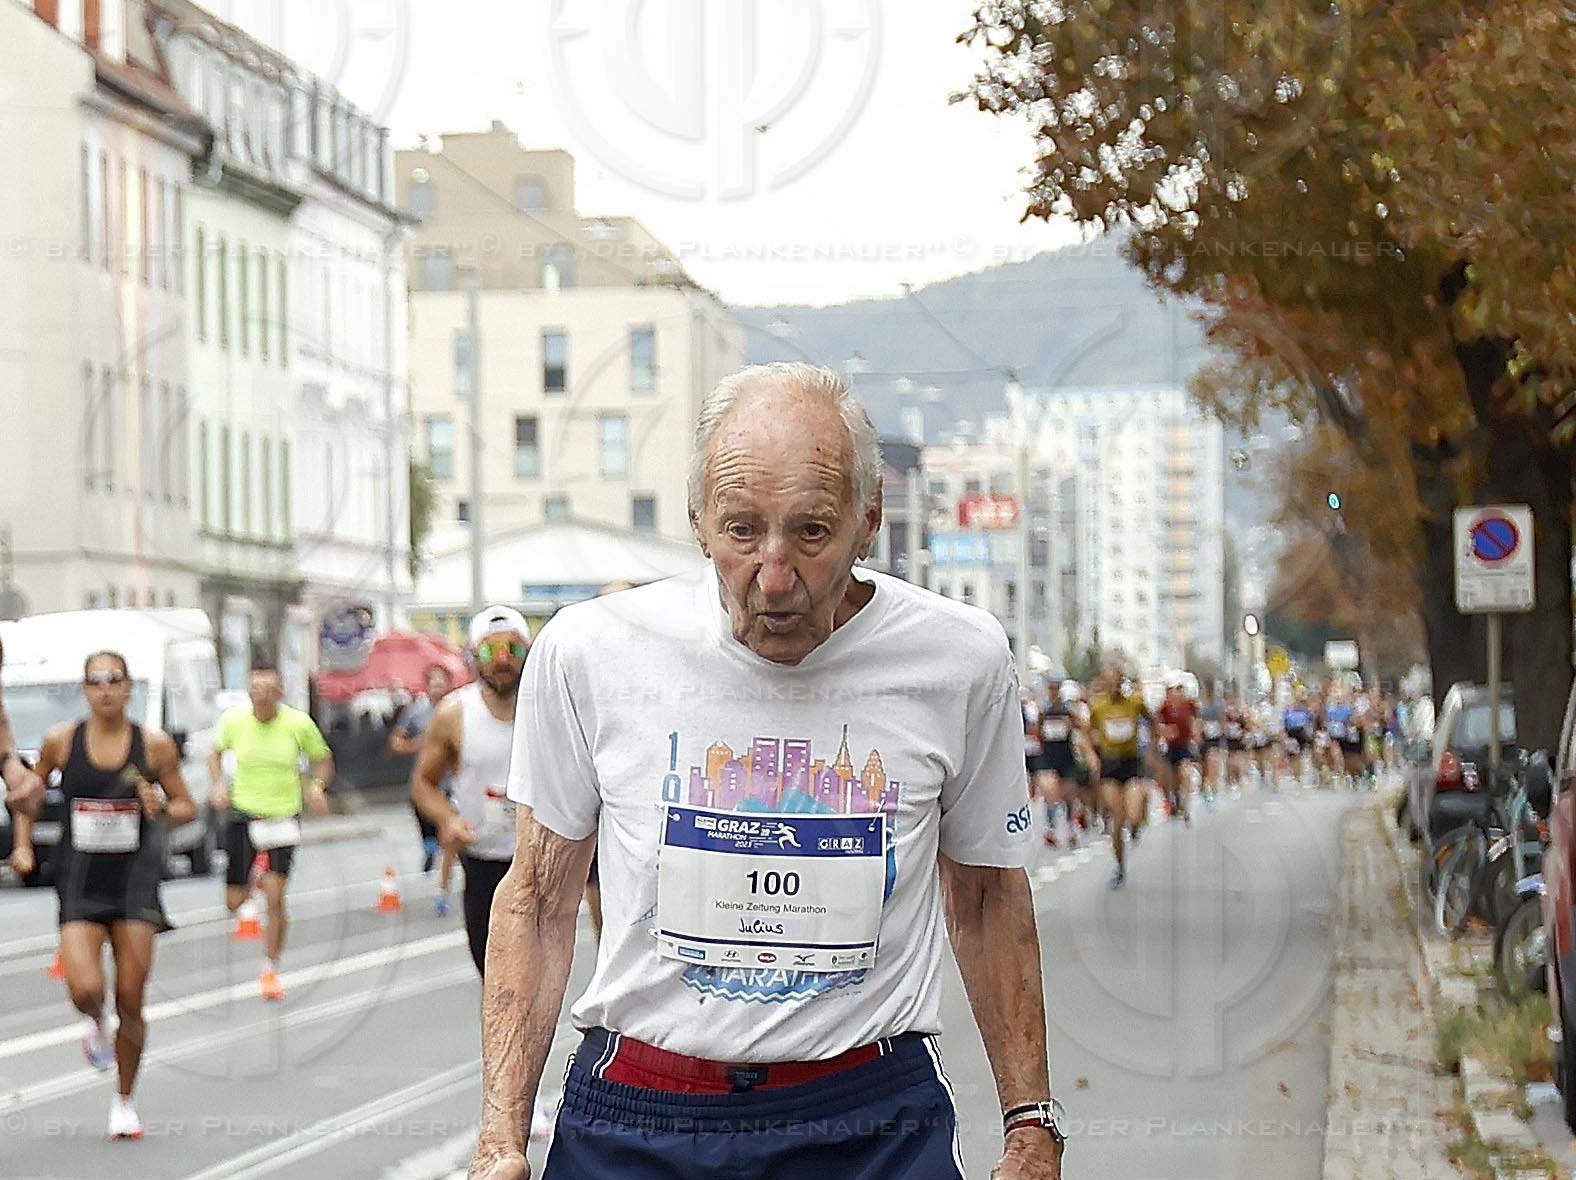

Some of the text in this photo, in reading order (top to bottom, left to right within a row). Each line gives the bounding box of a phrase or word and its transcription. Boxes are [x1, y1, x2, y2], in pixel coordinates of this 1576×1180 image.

[718, 819, 761, 834] GRAZ
[819, 838, 862, 850] GRAZ
[746, 869, 800, 896] 100
[715, 900, 827, 914] Kleine Zeitung Marathon
[738, 918, 784, 934] Julius
